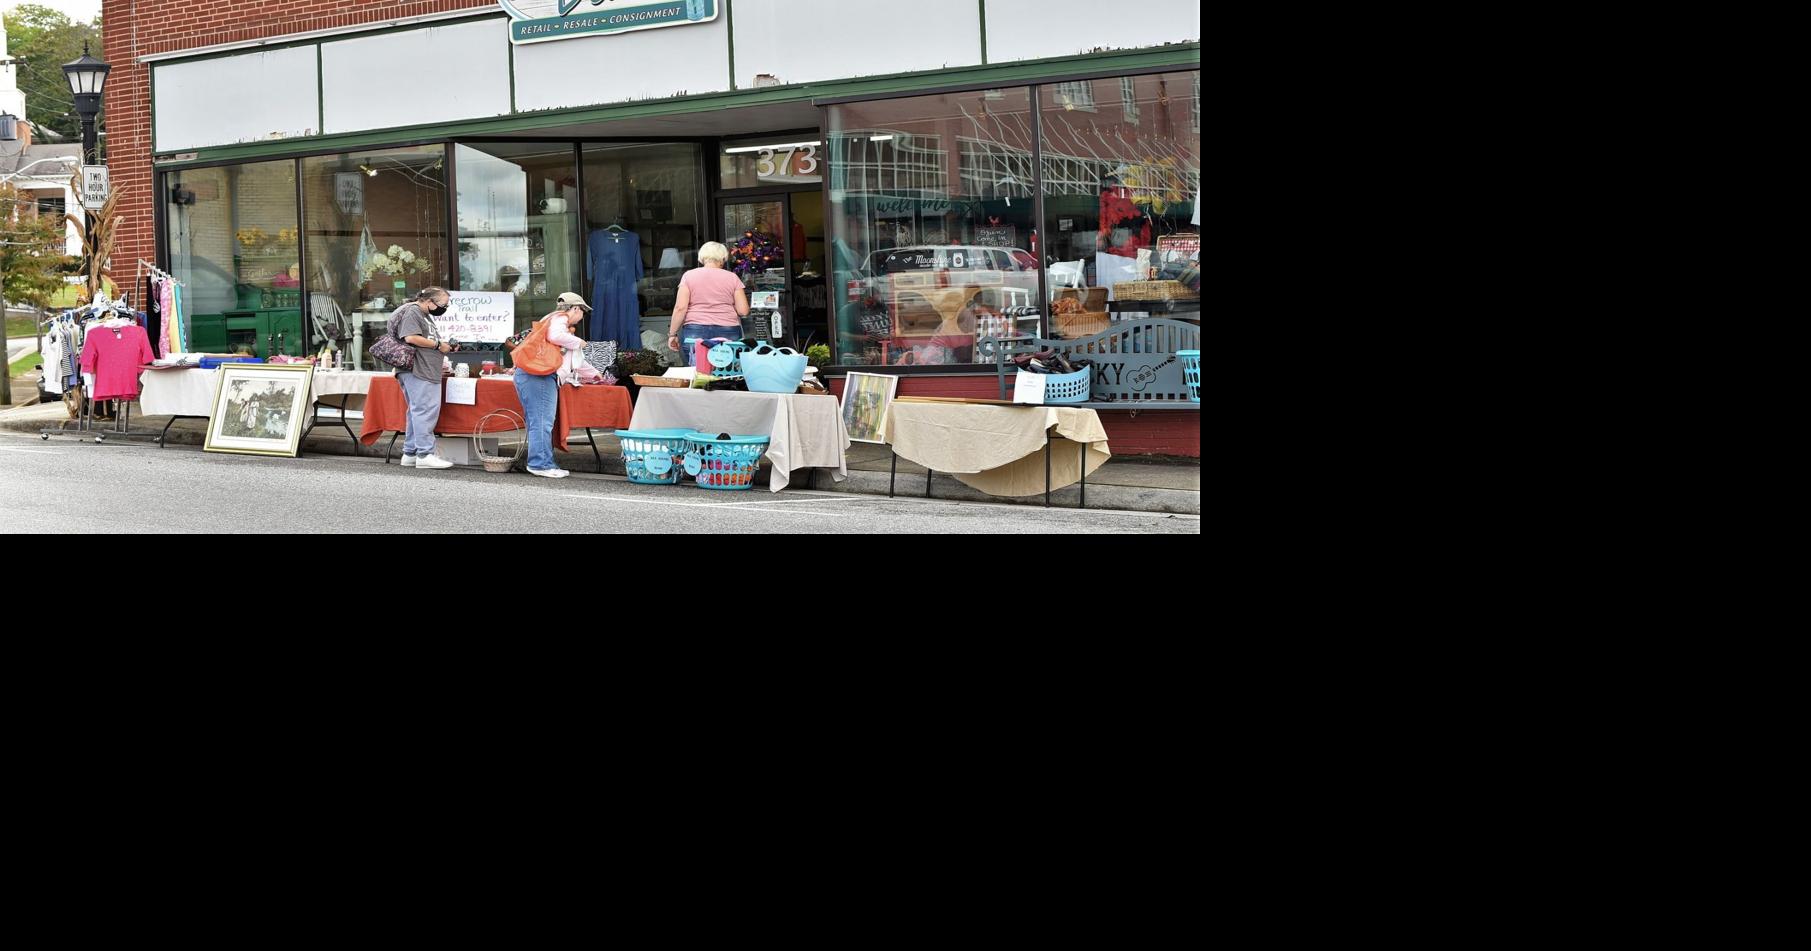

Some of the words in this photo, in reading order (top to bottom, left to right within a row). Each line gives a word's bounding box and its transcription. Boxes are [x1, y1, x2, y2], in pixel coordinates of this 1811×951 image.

[520, 23, 552, 35] RETAIL
[562, 17, 599, 30] RESALE
[609, 7, 681, 24] CONSIGNMENT
[757, 144, 817, 177] 373
[90, 172, 102, 181] TWO
[88, 183, 104, 192] HOUR
[450, 296, 492, 305] recrow
